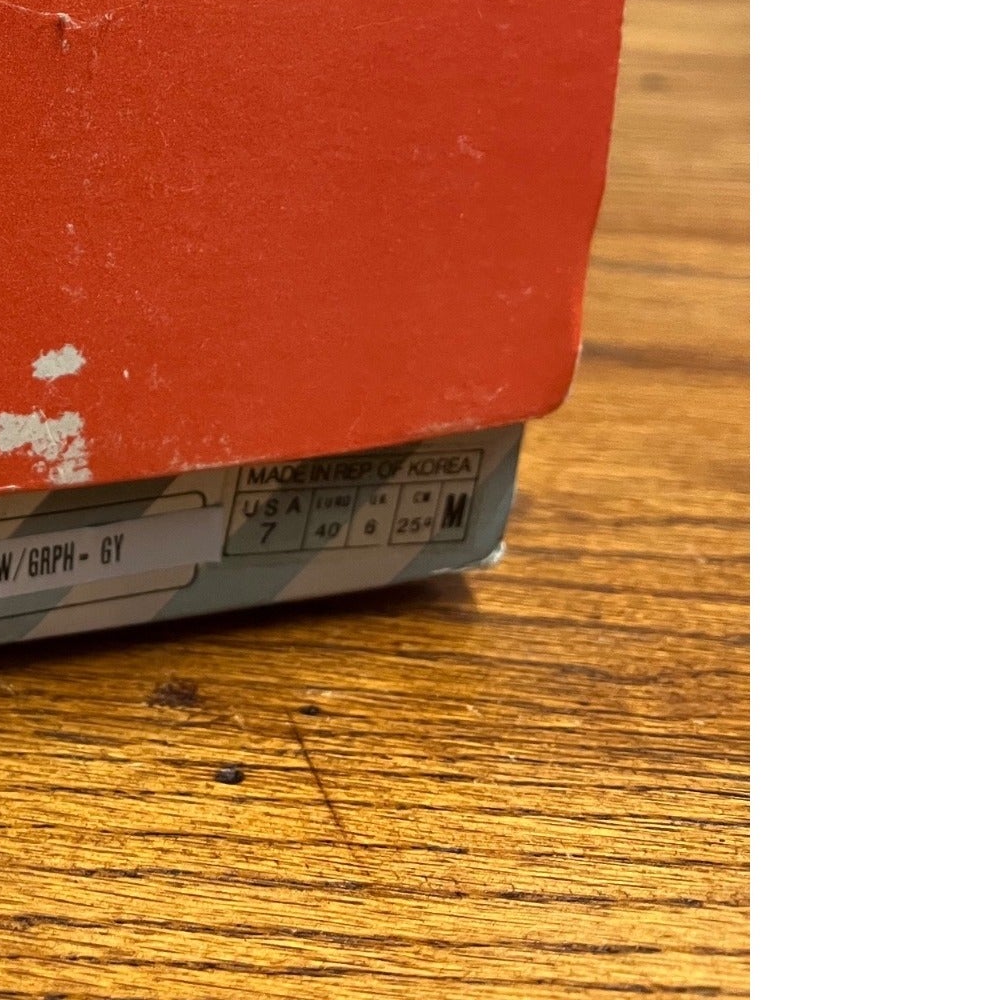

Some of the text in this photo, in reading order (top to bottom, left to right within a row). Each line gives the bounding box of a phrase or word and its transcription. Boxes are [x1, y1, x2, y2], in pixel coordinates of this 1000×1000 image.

[247, 466, 305, 485] MADE
[309, 463, 330, 480] IN
[376, 457, 404, 478] OF
[408, 456, 471, 475] KOREA
[441, 493, 468, 529] M
[259, 522, 276, 544] 7
[315, 523, 340, 538] 40
[364, 519, 376, 534] 6
